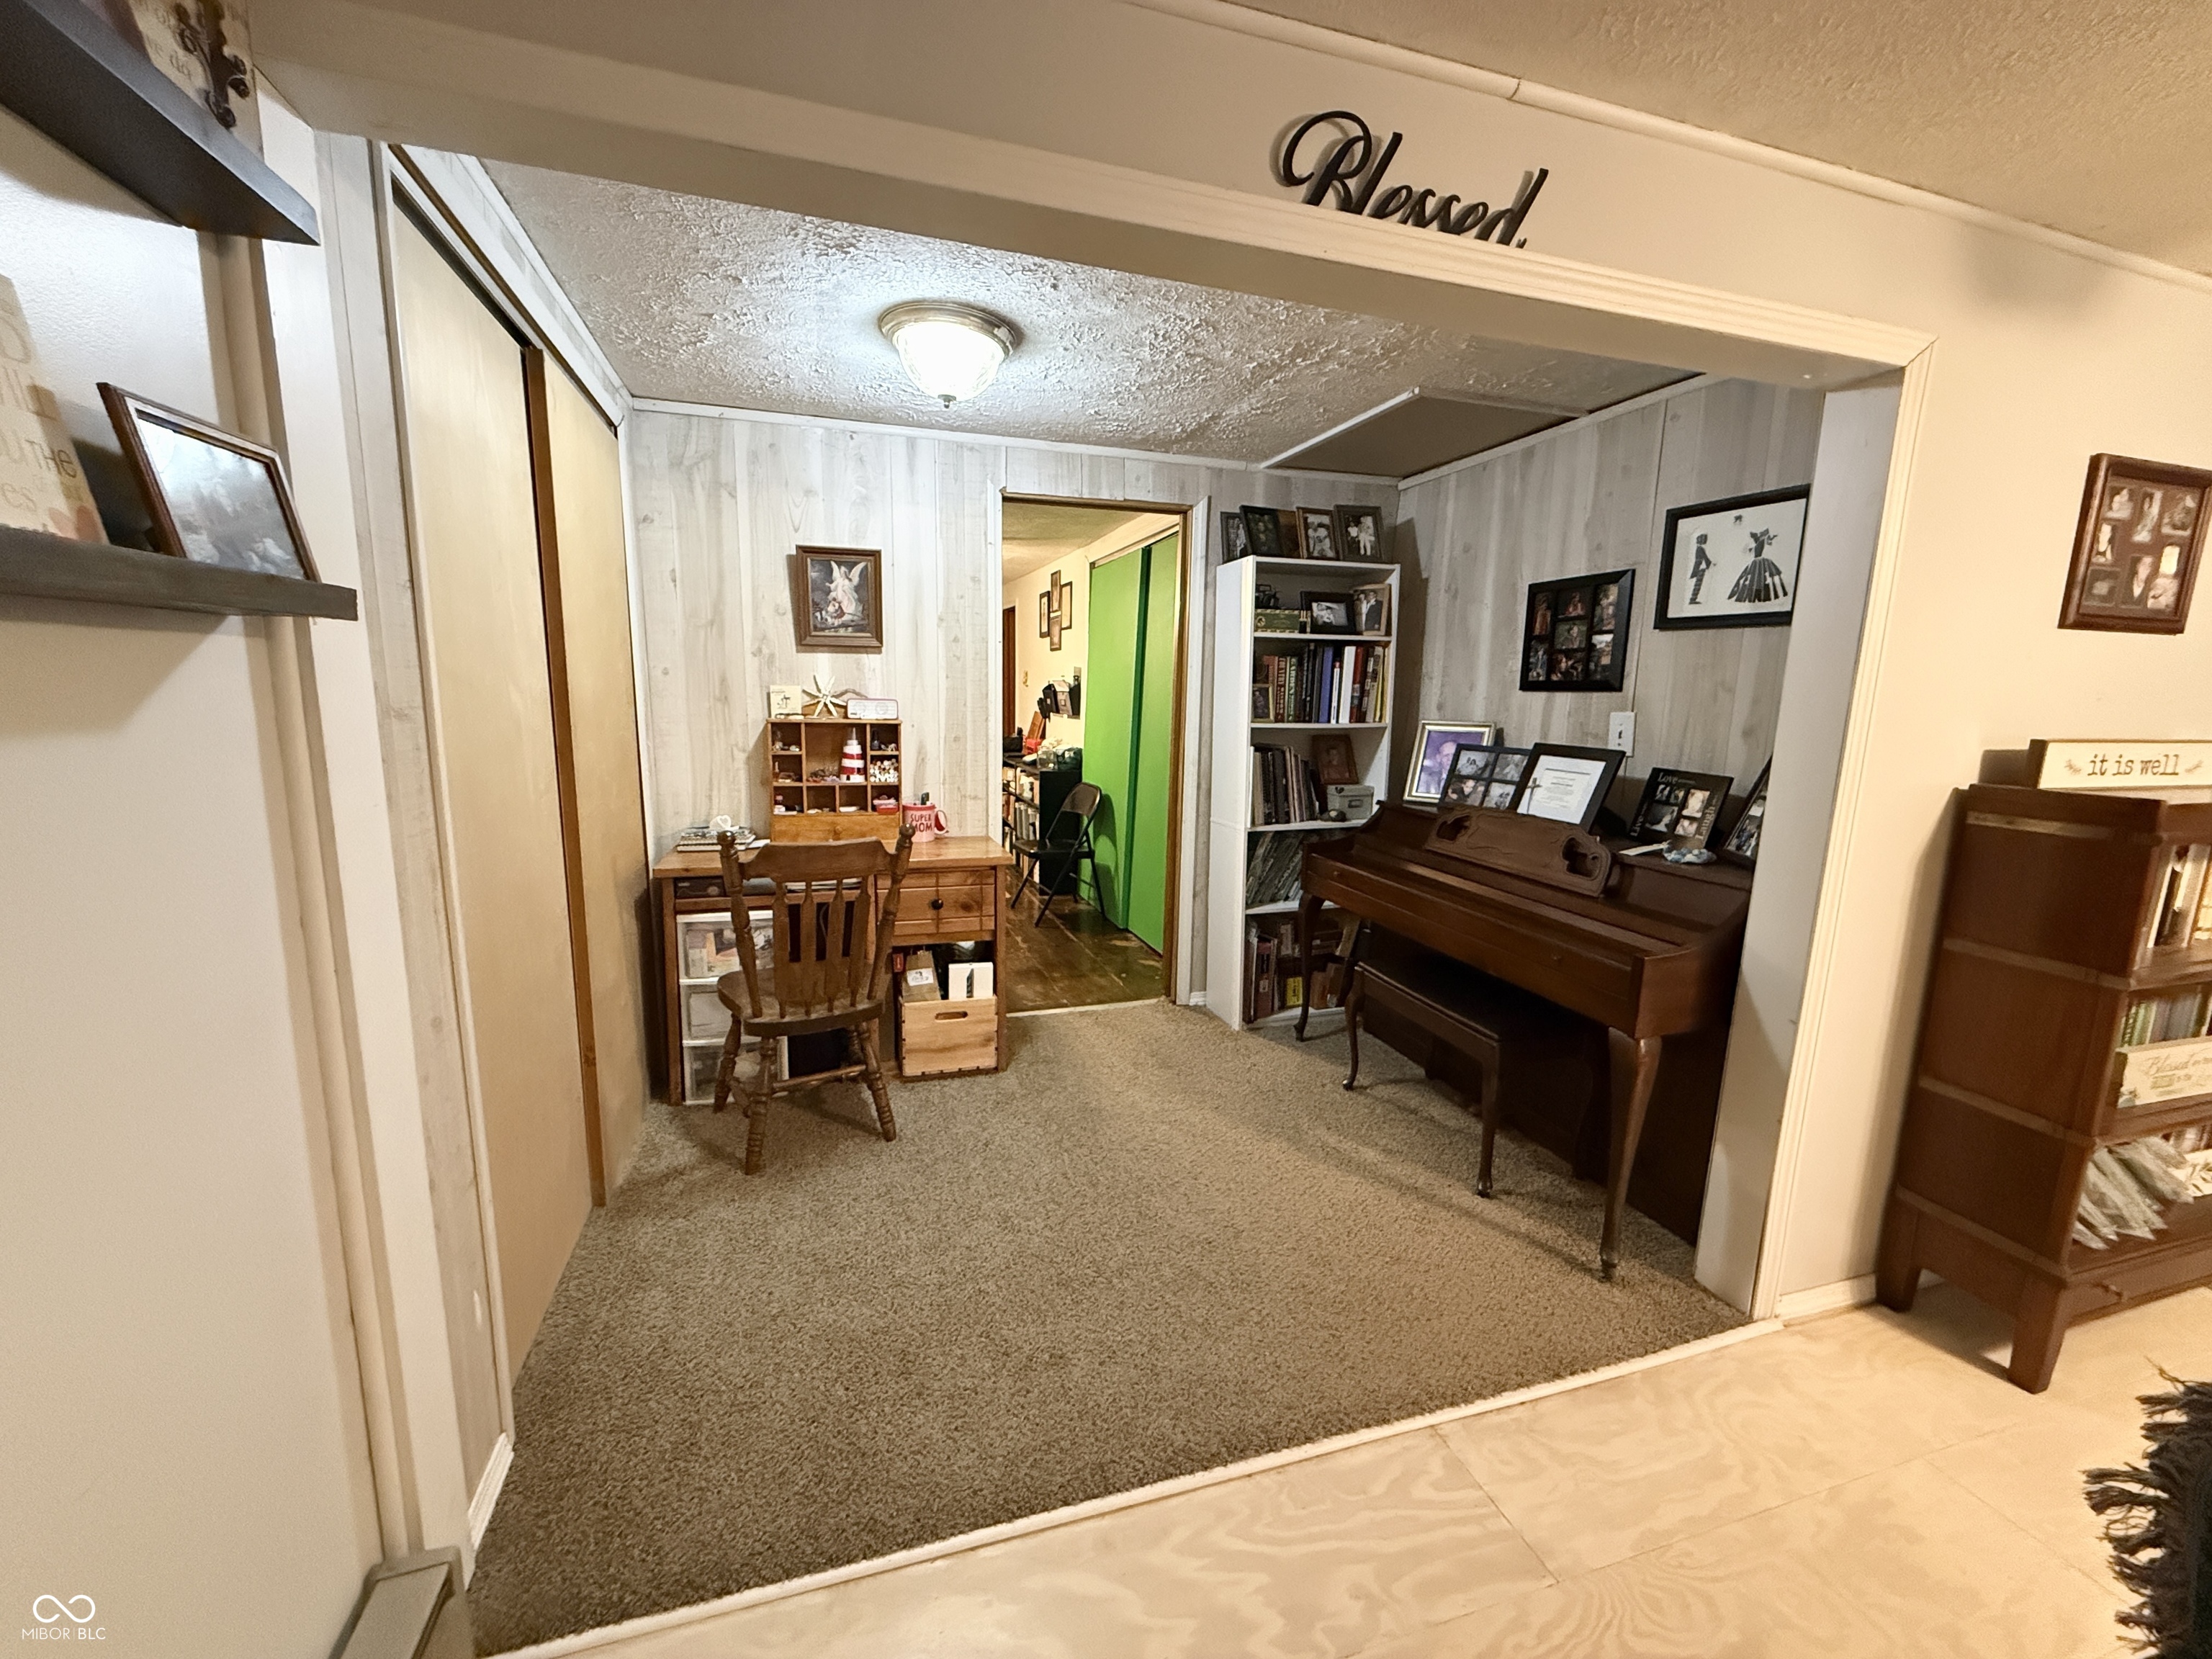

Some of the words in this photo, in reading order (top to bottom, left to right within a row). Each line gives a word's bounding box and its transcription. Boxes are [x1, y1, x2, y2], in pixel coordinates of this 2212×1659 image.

[2087, 754, 2108, 776] it
[2112, 754, 2134, 776] is
[2139, 754, 2180, 776] well
[1658, 772, 1678, 785] Love
[910, 814, 932, 822] SUPER
[1695, 806, 1716, 840] Laugh
